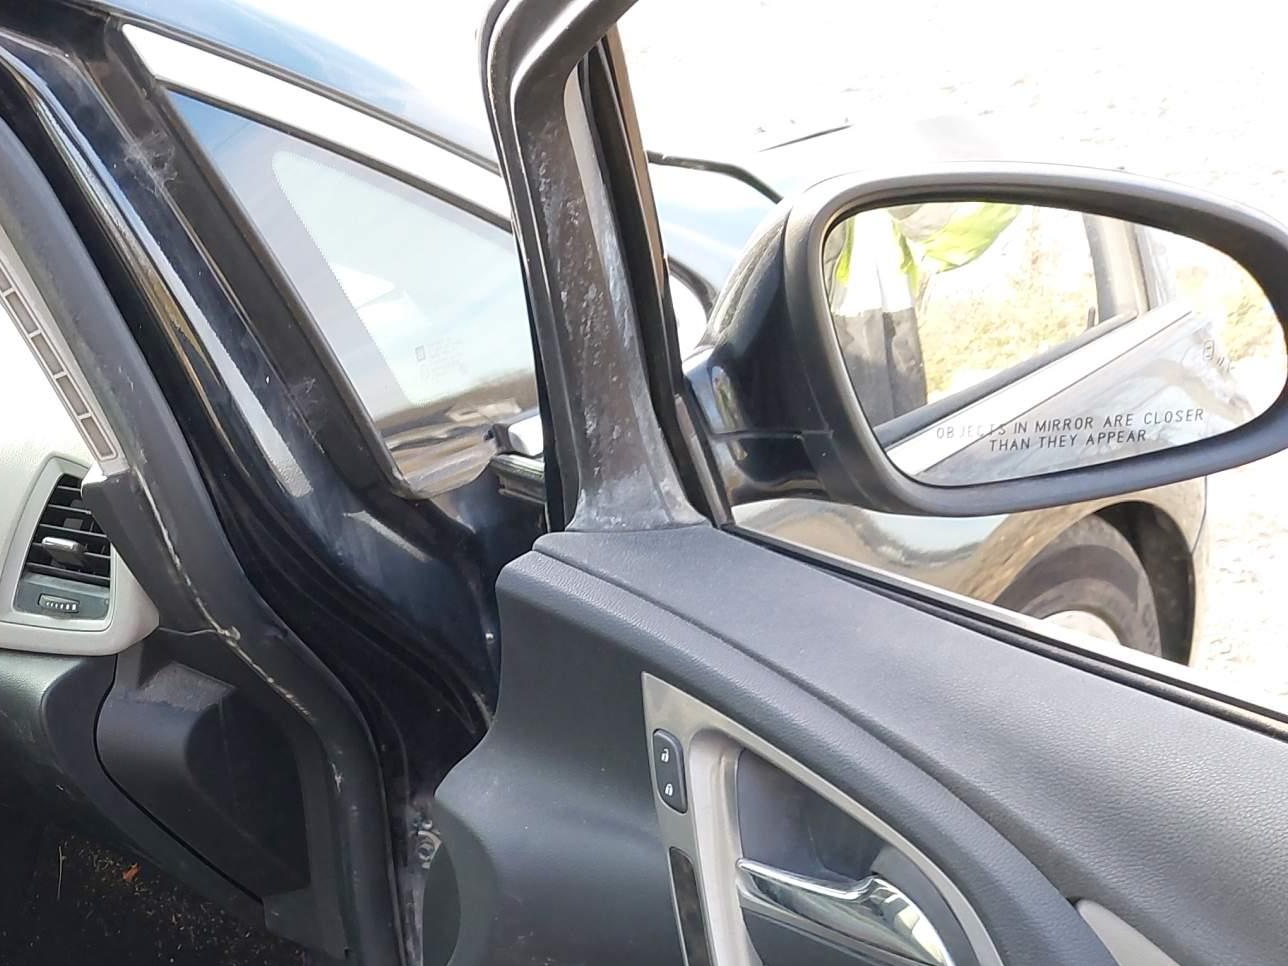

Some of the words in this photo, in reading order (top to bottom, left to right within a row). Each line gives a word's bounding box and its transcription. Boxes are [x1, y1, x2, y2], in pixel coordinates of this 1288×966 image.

[936, 423, 1006, 440] OBJECTS
[1014, 422, 1029, 435] IN
[1035, 416, 1094, 432] MIRROR
[1103, 413, 1134, 429] ARE
[1143, 408, 1205, 425] CLOSER
[990, 438, 1031, 451] THAN
[1039, 434, 1078, 449] THEY
[1086, 429, 1147, 446] APPEAR
